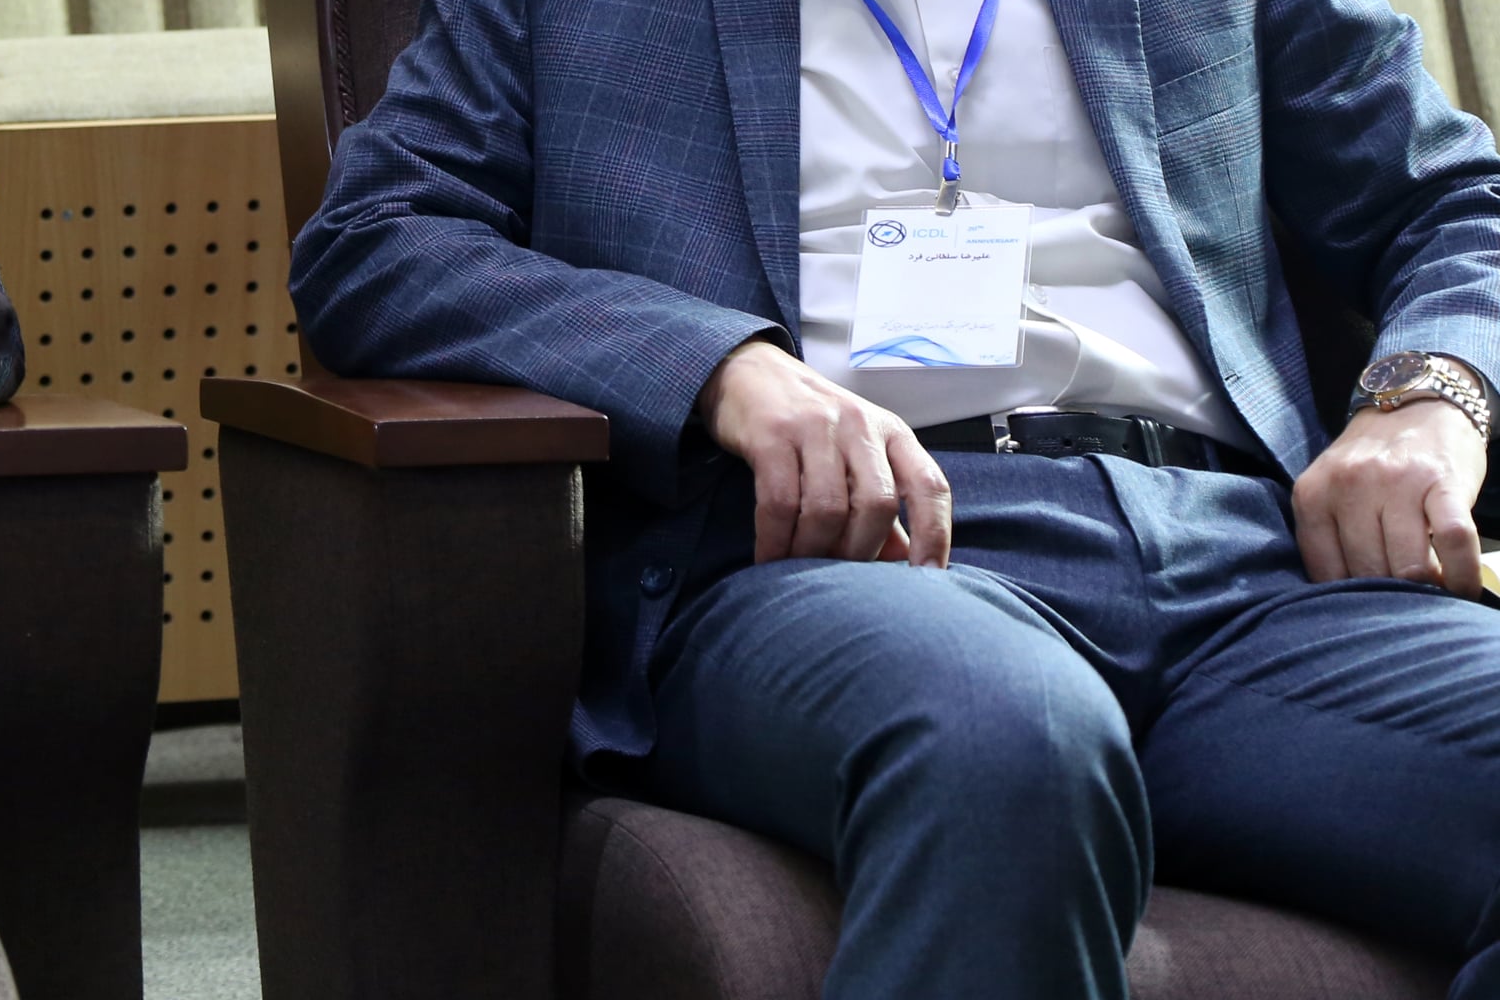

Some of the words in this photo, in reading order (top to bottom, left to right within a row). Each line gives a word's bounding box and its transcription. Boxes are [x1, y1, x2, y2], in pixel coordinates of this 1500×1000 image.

[912, 228, 949, 238] ICDL
[925, 252, 958, 262] سلطانی
[960, 252, 990, 262] علیرضا
